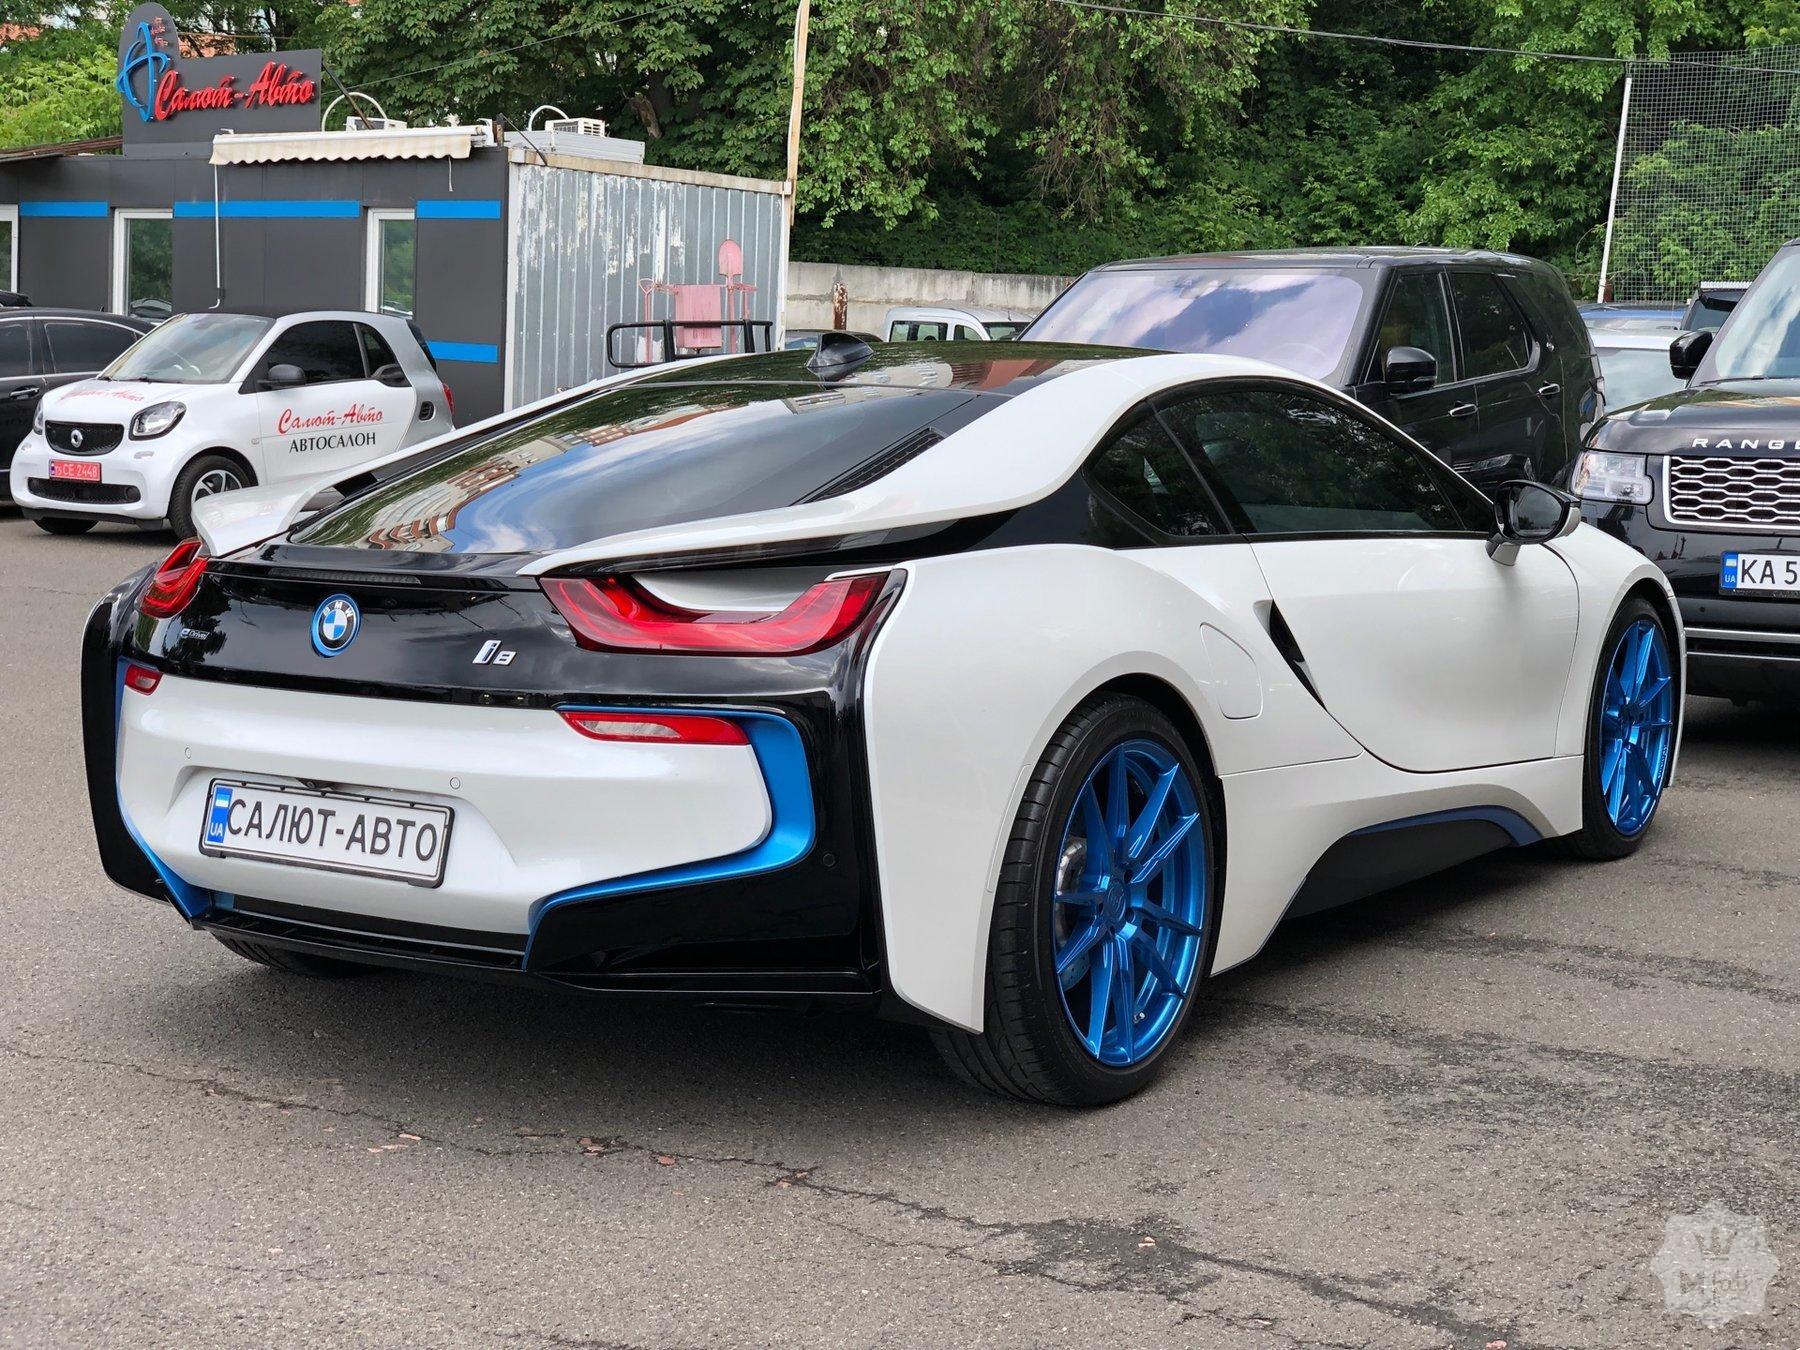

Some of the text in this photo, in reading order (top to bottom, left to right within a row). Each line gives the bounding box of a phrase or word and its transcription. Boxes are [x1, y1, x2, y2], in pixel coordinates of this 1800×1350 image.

[278, 403, 383, 434] Салют-Авто
[289, 432, 376, 453] АВТОСАЛОН
[1724, 574, 1736, 583] UA
[1741, 559, 1776, 584] KA
[322, 600, 354, 618] BMW
[472, 639, 517, 666] i8
[209, 821, 224, 838] UA
[227, 798, 438, 862] САЛЮТ-АВТО
